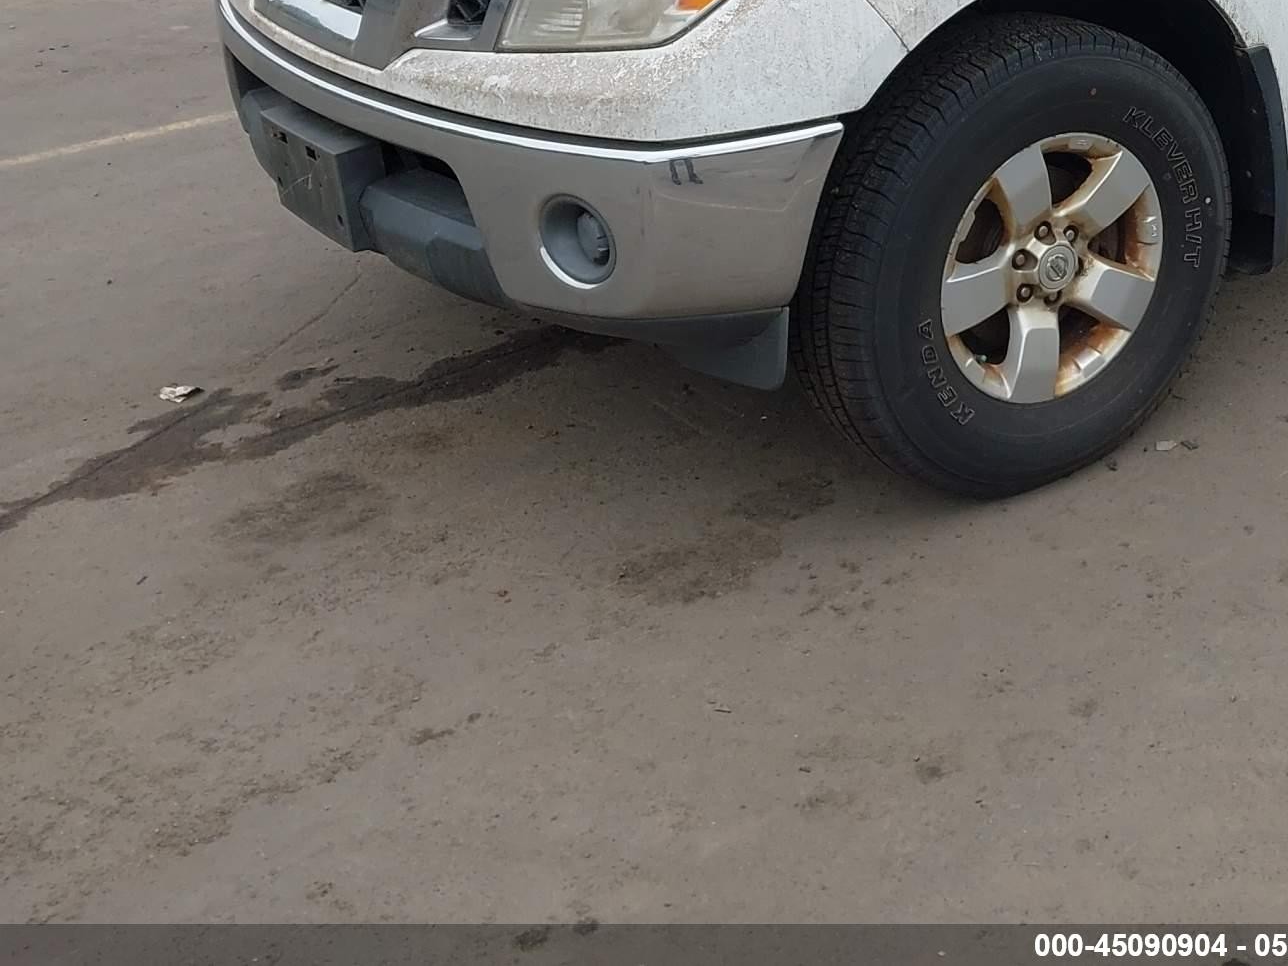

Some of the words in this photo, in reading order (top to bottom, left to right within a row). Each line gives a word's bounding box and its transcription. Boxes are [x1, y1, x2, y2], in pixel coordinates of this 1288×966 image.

[1122, 105, 1199, 204] KLEVER
[1183, 206, 1202, 268] H/T
[918, 318, 975, 425] KENDA
